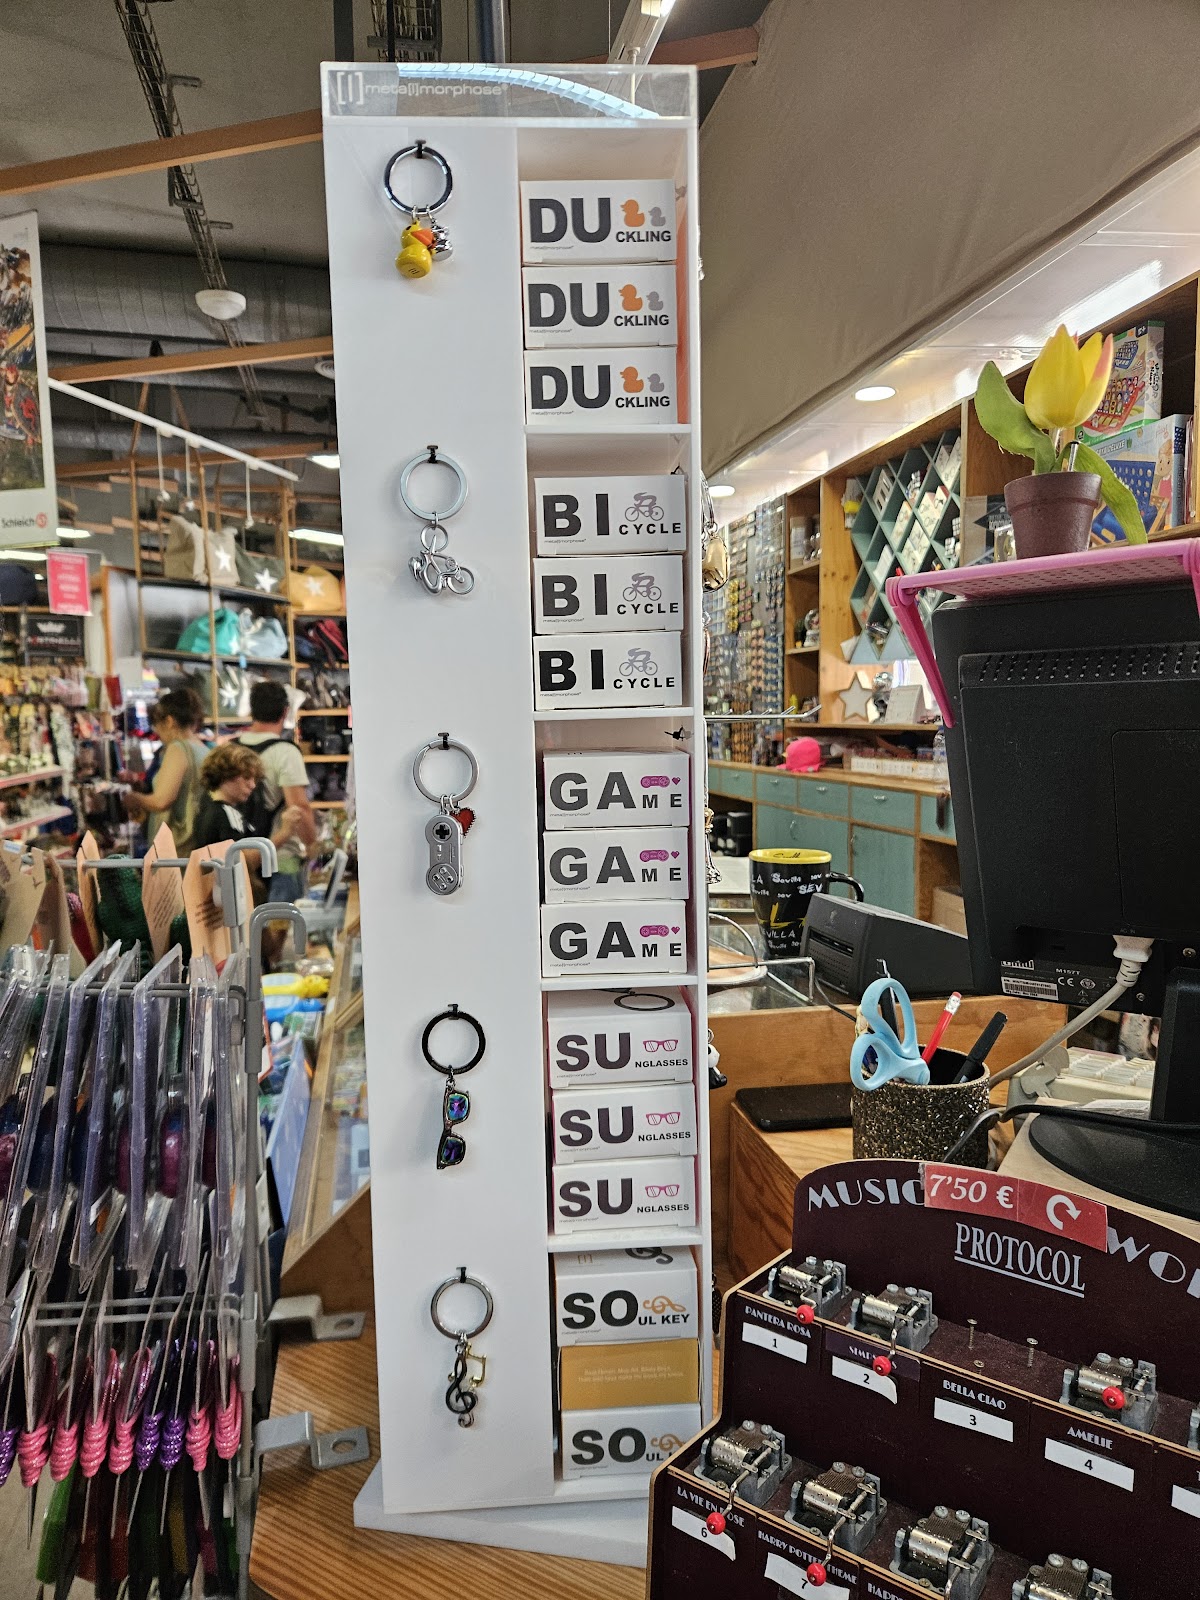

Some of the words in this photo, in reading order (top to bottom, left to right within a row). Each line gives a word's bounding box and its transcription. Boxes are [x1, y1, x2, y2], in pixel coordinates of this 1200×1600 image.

[528, 197, 612, 243] DU
[615, 230, 672, 243] CKLING
[527, 282, 610, 328] DU
[613, 314, 670, 327] CKLING
[529, 365, 612, 410] DU
[615, 396, 671, 409] CKLING
[542, 493, 610, 538] BI
[618, 522, 682, 535] CYCLE
[541, 573, 608, 617] BI
[616, 602, 679, 615] CYCLE
[538, 649, 605, 692] BI
[613, 677, 675, 689] CYCLE
[549, 771, 637, 811] GA
[642, 793, 683, 809] ME
[549, 846, 636, 885] GA
[641, 867, 682, 883] ME
[549, 921, 636, 961] GA
[642, 942, 682, 958] ME
[555, 1032, 632, 1072] SU
[635, 1058, 689, 1068] NGLASSES
[559, 1105, 634, 1147] SU
[638, 1131, 692, 1142] NGLASSES
[558, 1177, 633, 1218] SU
[636, 1203, 690, 1214] NGLASSES
[996, 1185, 1014, 1210] €
[954, 1221, 1086, 1291] PROTOCOL
[562, 1289, 639, 1330] SO
[638, 1315, 657, 1326] UL
[661, 1313, 691, 1325] KEY
[744, 1305, 786, 1329] PANTERA
[786, 1321, 812, 1339] ROSA
[771, 1338, 778, 1349] 1
[863, 1373, 870, 1385] 2
[942, 1379, 977, 1401] BELLA
[977, 1391, 1007, 1411] CIAO
[969, 1414, 977, 1426] 3
[1067, 1426, 1114, 1451] AMELIE
[571, 1427, 647, 1466] SO
[1084, 1459, 1093, 1471] 4
[677, 1485, 688, 1500] LA
[689, 1491, 704, 1508] VIE
[701, 1527, 708, 1538] 6
[757, 1530, 788, 1551] HARRY
[826, 1563, 858, 1585] THEME
[801, 1577, 809, 1589] 7
